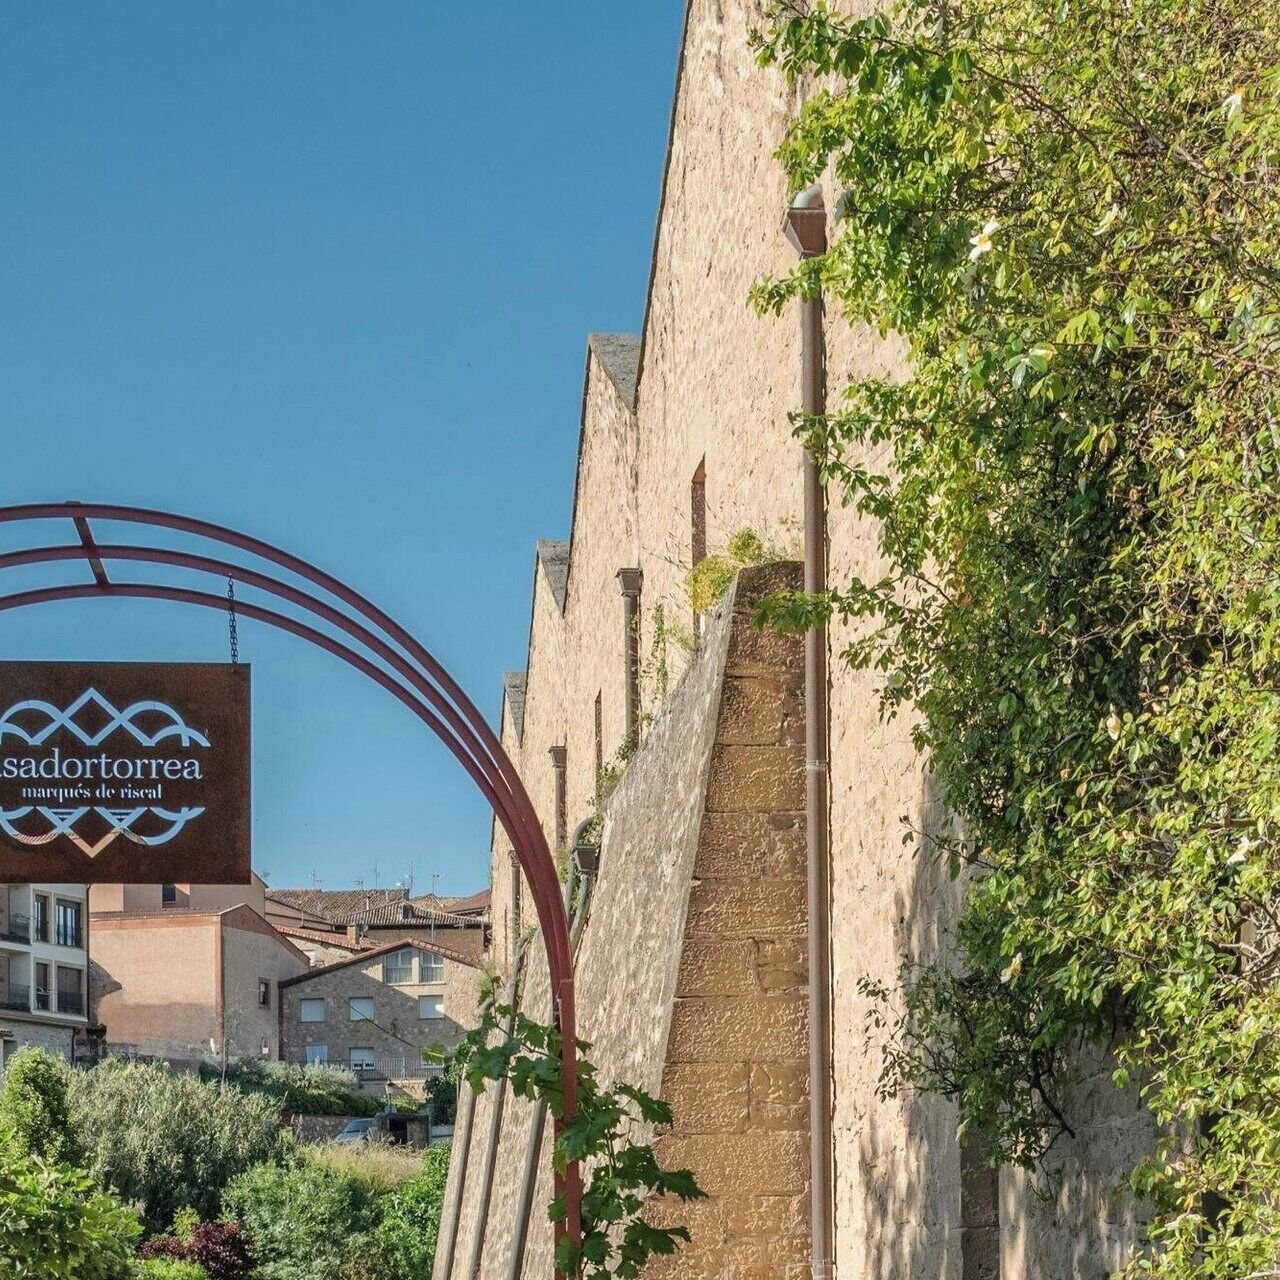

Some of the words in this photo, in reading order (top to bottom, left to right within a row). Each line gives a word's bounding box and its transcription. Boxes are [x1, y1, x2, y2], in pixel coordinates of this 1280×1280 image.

[23, 783, 91, 803] marqués
[96, 784, 116, 799] de
[120, 784, 162, 799] riscal
